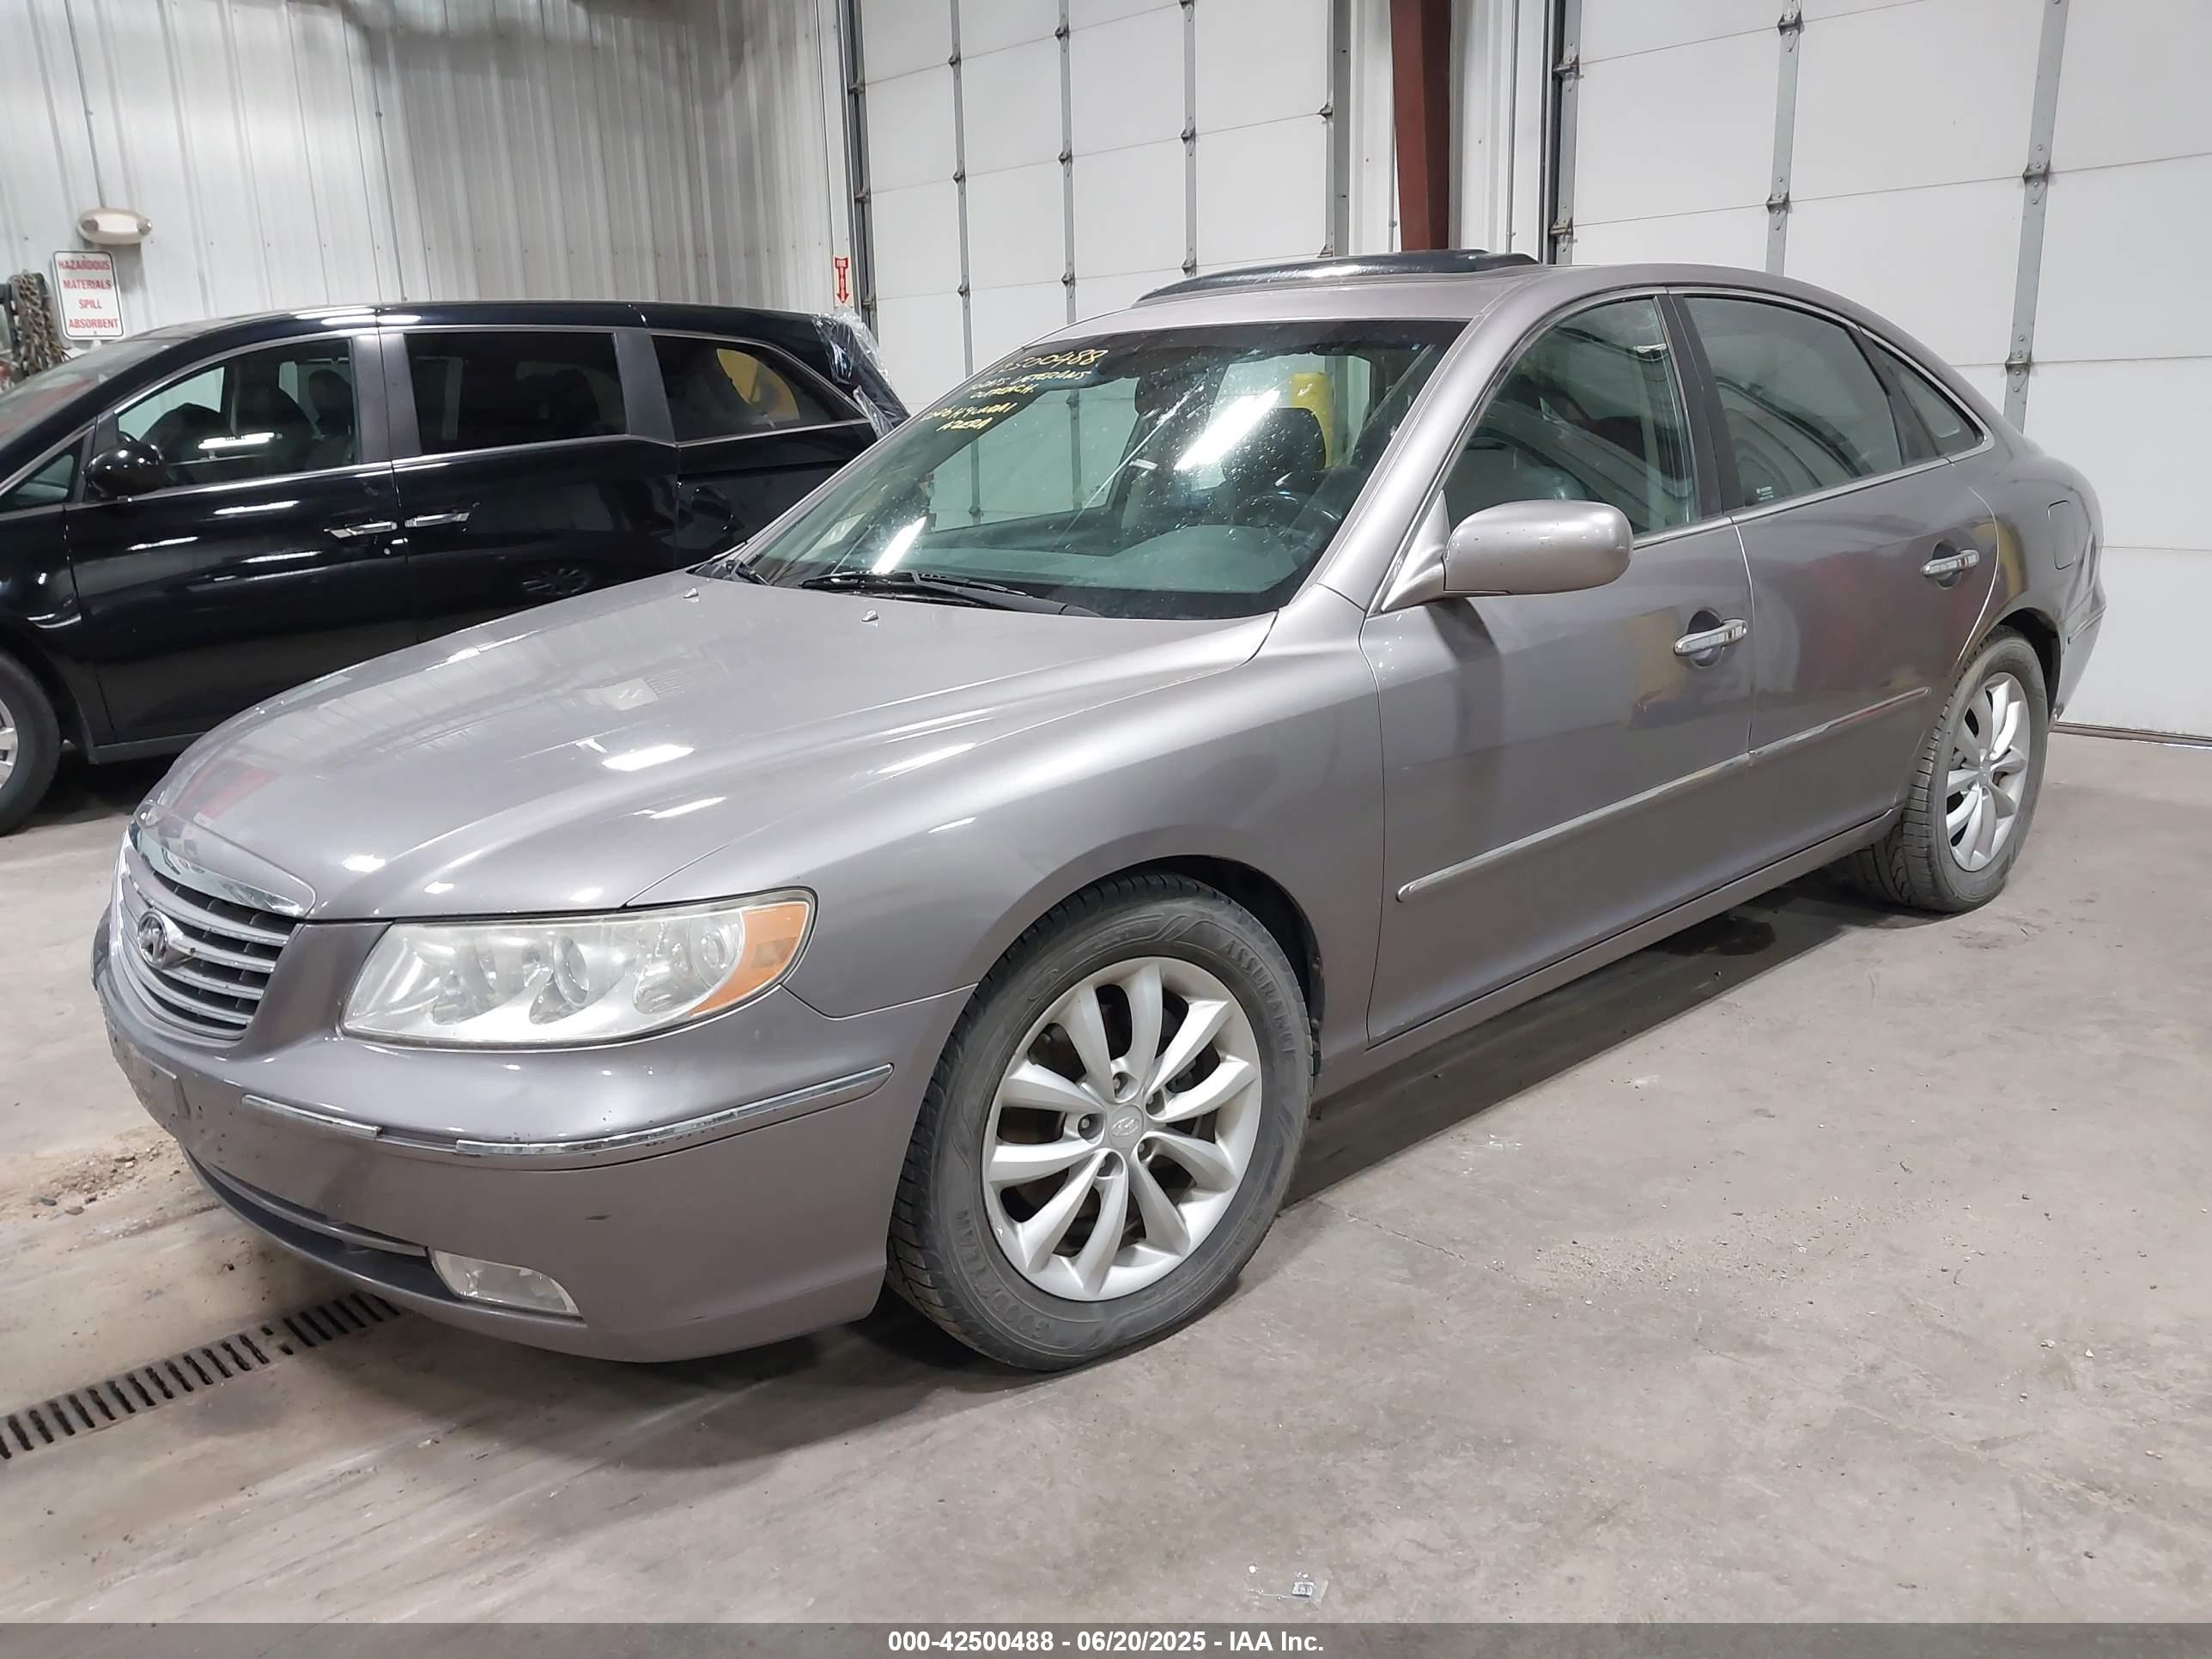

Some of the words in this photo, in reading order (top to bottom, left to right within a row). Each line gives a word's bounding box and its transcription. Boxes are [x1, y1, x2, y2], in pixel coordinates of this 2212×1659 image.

[58, 259, 111, 270] HAZARDOUS
[63, 279, 112, 289] MATERIALS
[78, 298, 103, 309] SPILL
[69, 318, 118, 329] ABSORBENT
